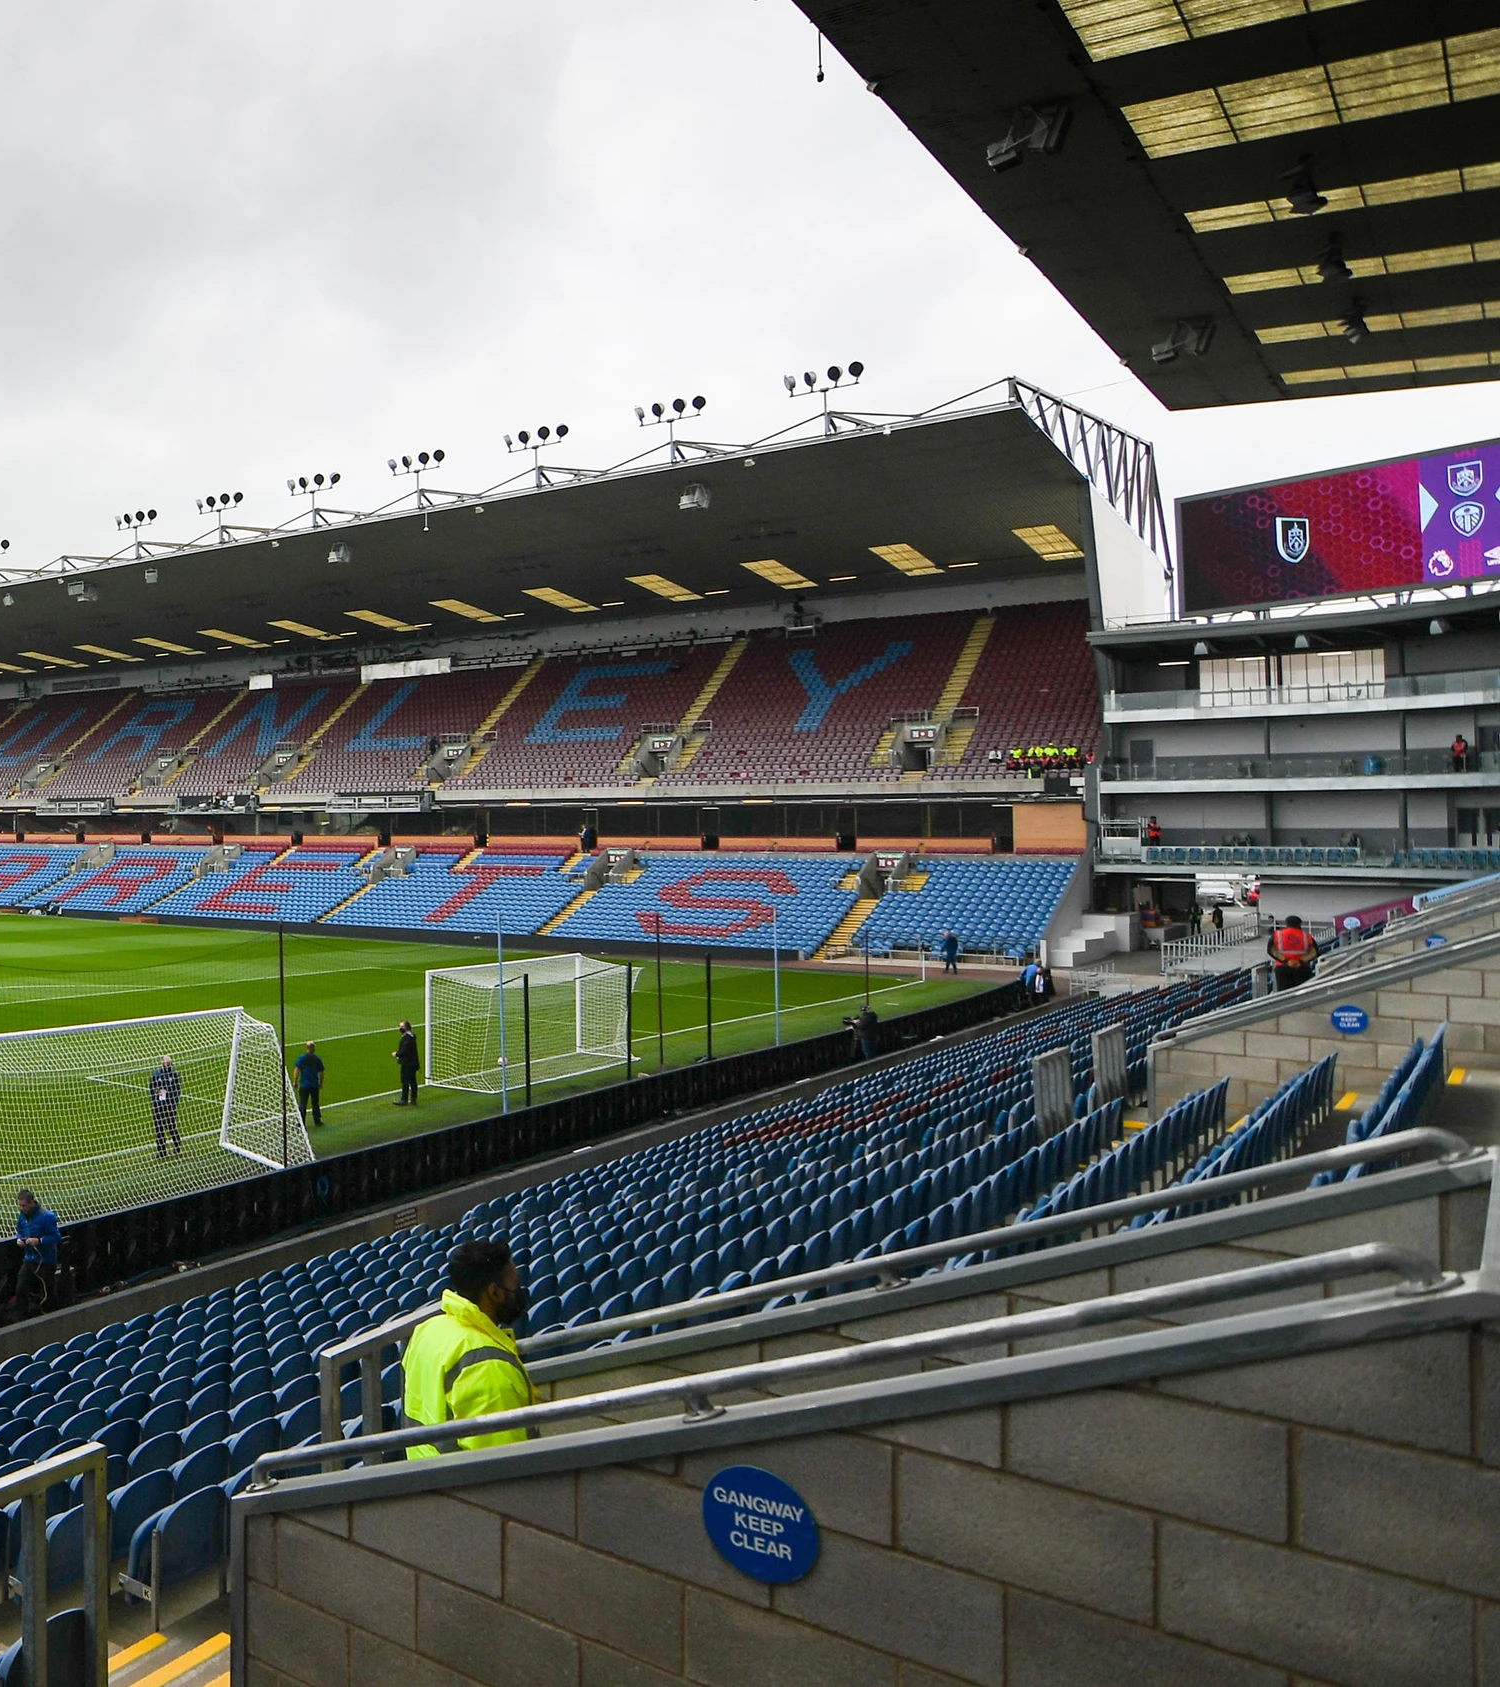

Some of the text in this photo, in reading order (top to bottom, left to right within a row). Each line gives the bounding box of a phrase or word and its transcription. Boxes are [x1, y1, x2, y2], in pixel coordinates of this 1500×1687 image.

[713, 1486, 804, 1522] GANGWAY
[734, 1512, 784, 1536] KEEP
[730, 1530, 792, 1561] CLEAR
